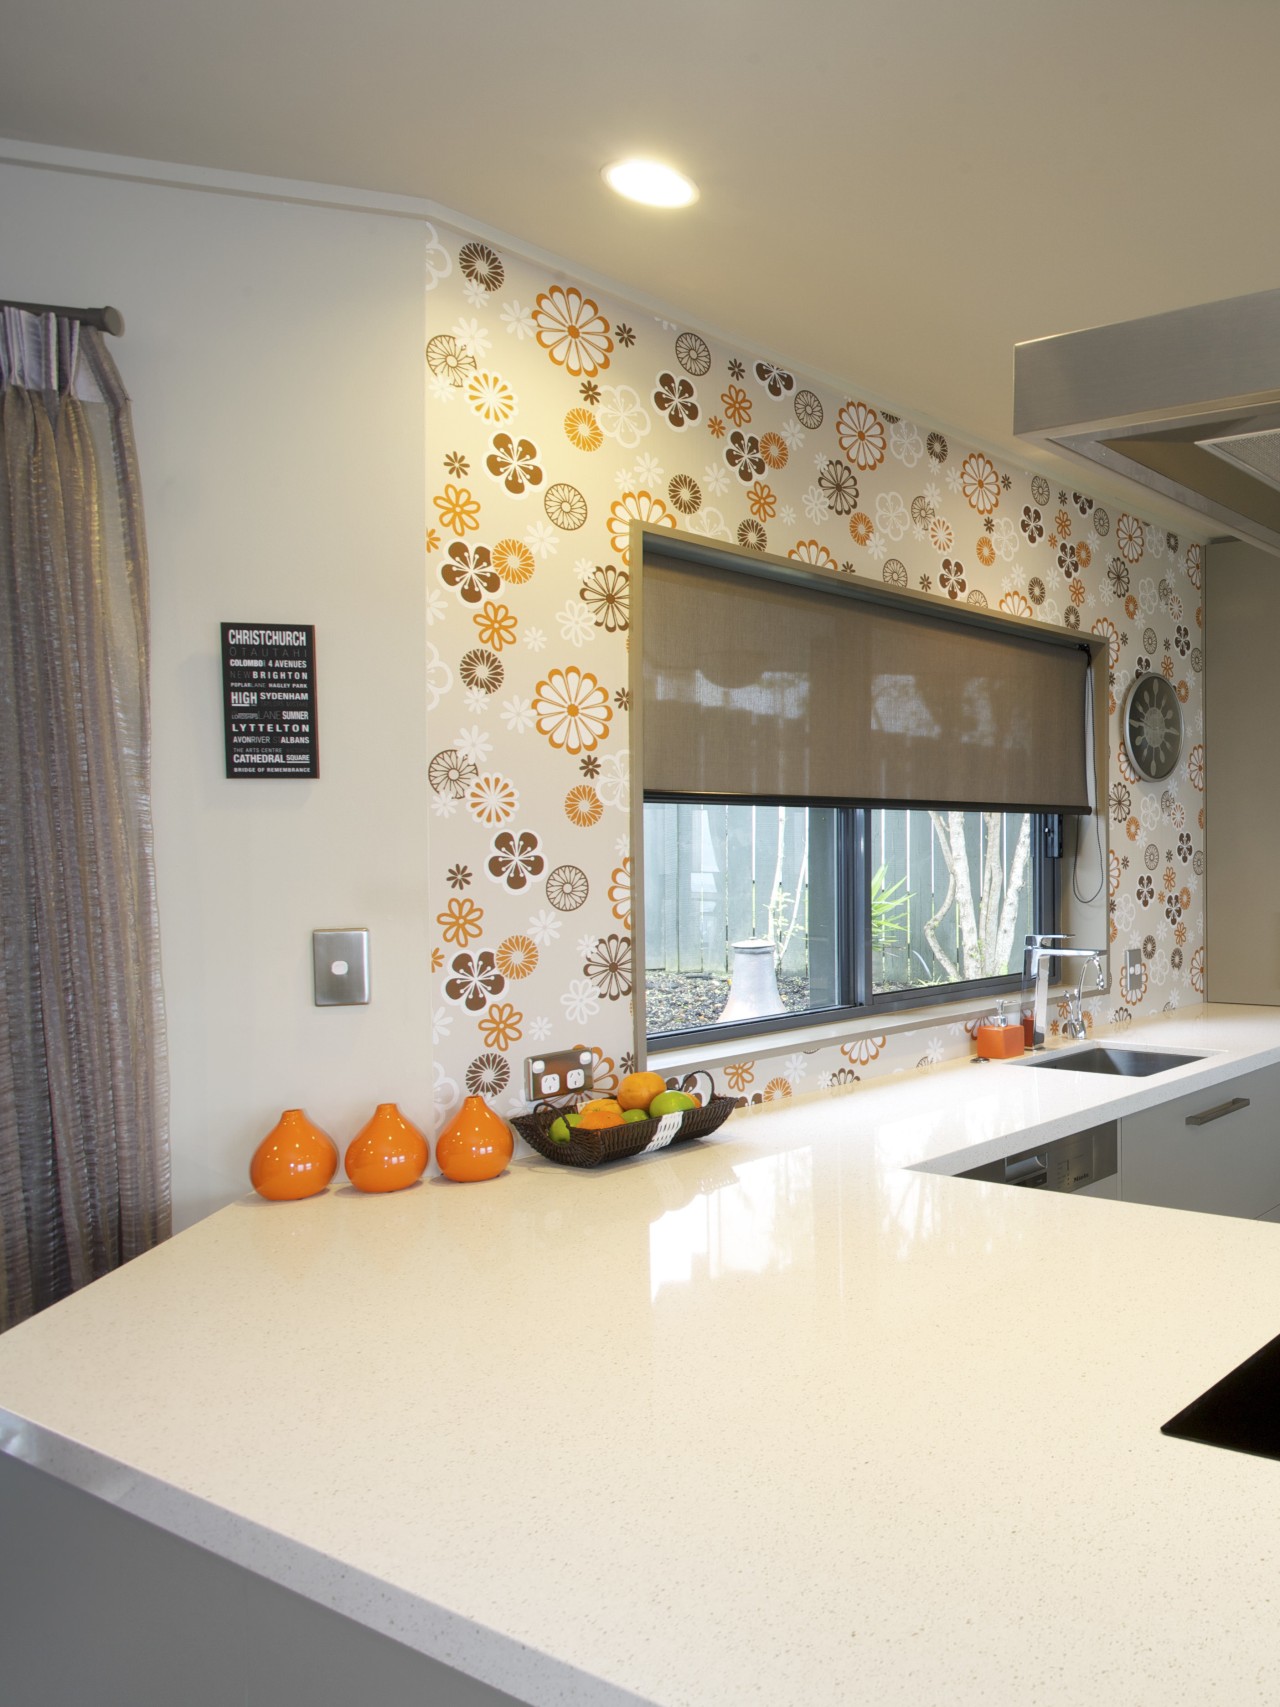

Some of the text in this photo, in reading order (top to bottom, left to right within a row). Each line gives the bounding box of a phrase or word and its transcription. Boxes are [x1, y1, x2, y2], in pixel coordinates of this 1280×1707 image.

[228, 629, 307, 646] CHRISTCHURCH
[229, 647, 307, 658] OTAUTAHI
[230, 659, 263, 667] COLOMBO
[268, 660, 273, 668] 4
[274, 660, 307, 668] AVENUES
[252, 671, 308, 680] BRIGHTON
[231, 692, 309, 704] HIGH SYDENHAM
[282, 711, 309, 720] SUMNER
[231, 723, 310, 732] LYTTELTON
[281, 736, 310, 744] ALBANS
[233, 754, 286, 764] CATHEDRAL
